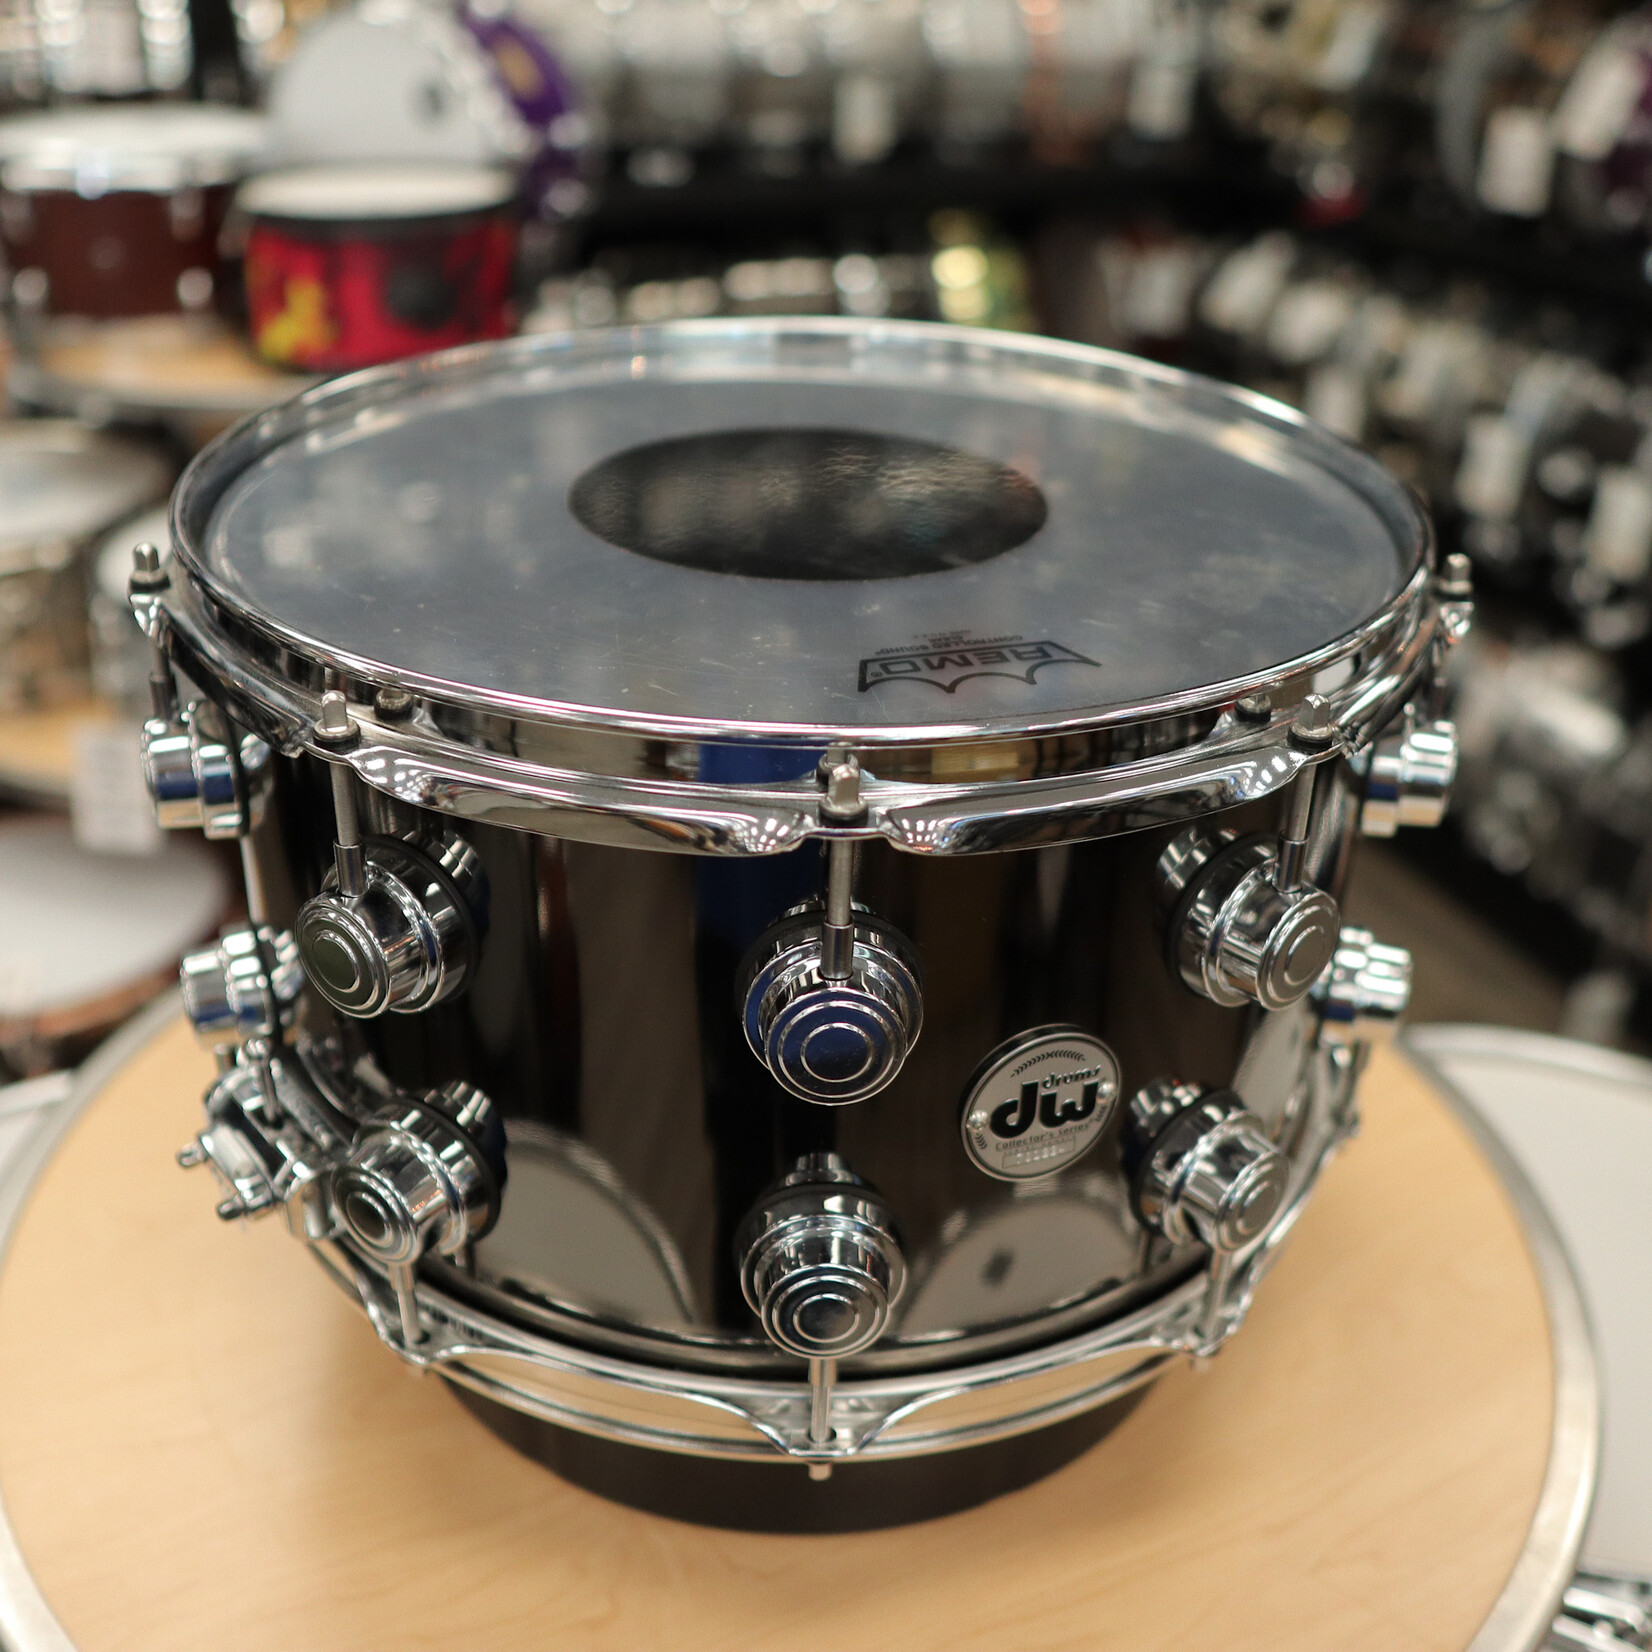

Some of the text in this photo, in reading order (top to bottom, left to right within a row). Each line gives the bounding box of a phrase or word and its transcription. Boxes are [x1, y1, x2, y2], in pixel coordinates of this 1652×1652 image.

[879, 646, 1053, 675] REMO
[1042, 1065, 1101, 1089] drums
[990, 1080, 1099, 1139] dw
[995, 1132, 1054, 1150] Collector's
